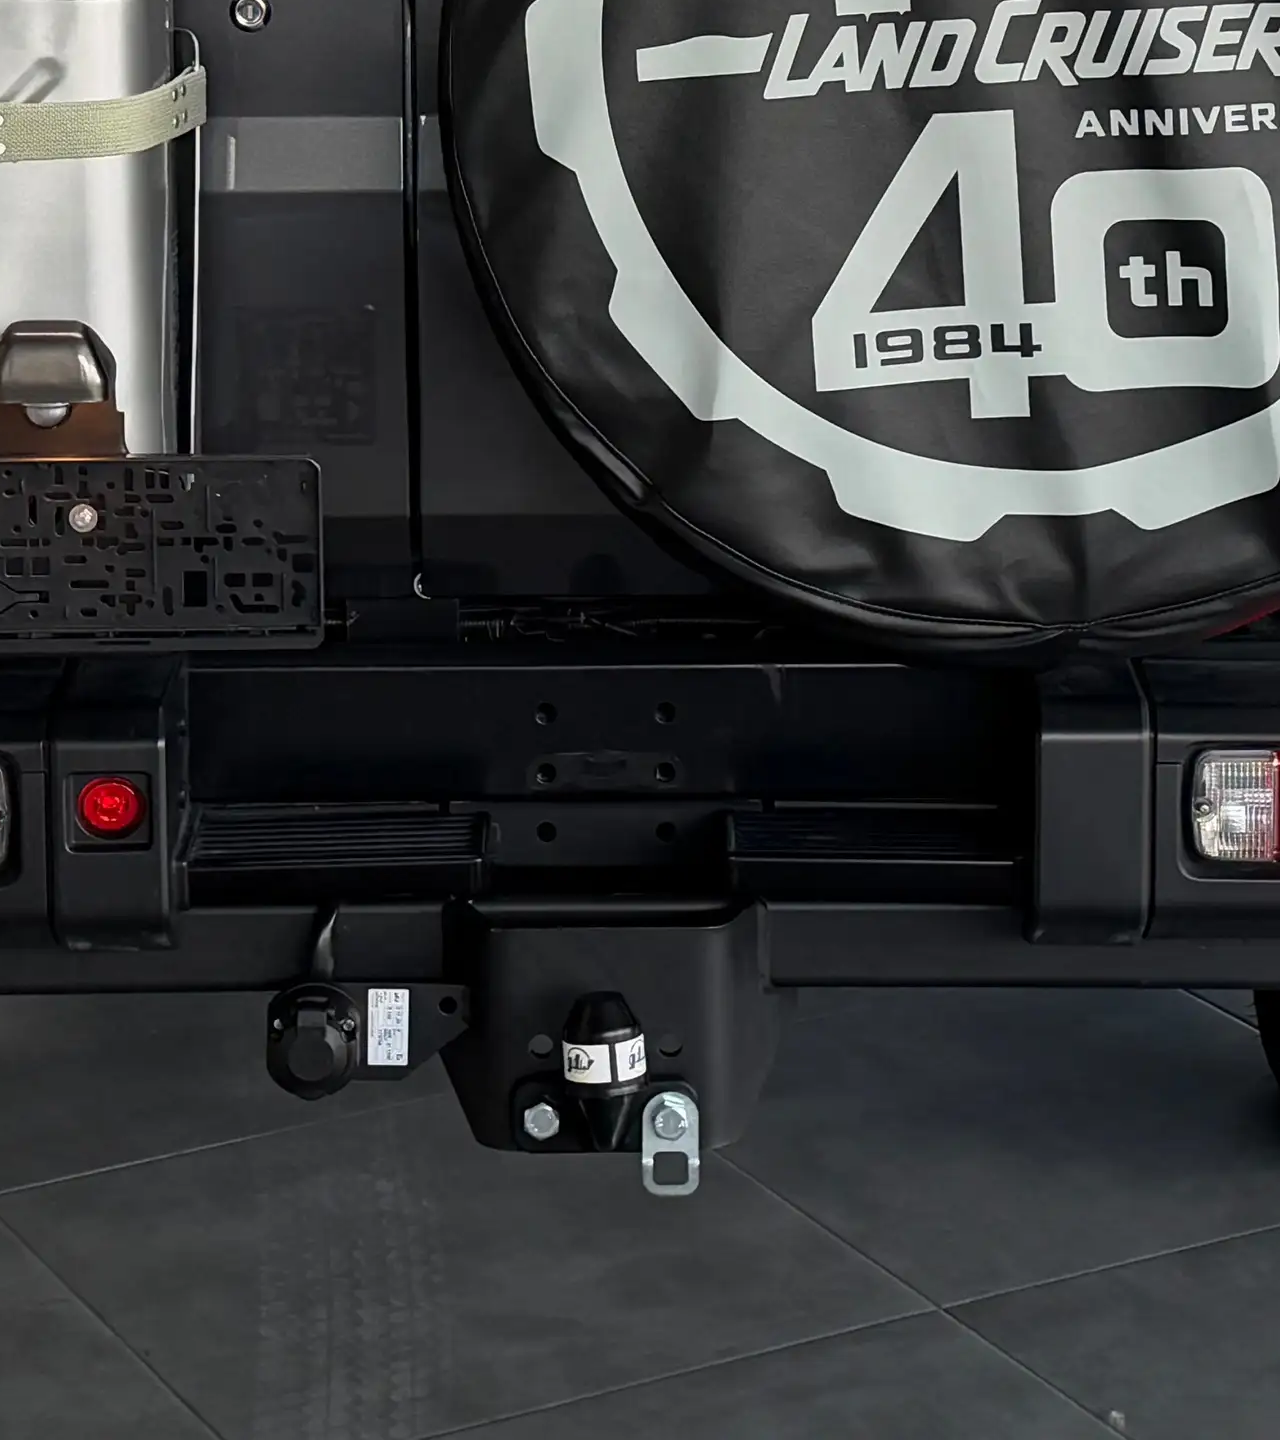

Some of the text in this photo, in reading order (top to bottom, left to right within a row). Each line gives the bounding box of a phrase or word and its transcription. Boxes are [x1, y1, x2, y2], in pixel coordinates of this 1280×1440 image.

[811, 109, 1280, 419] 40 th
[853, 322, 1042, 369] 1984
